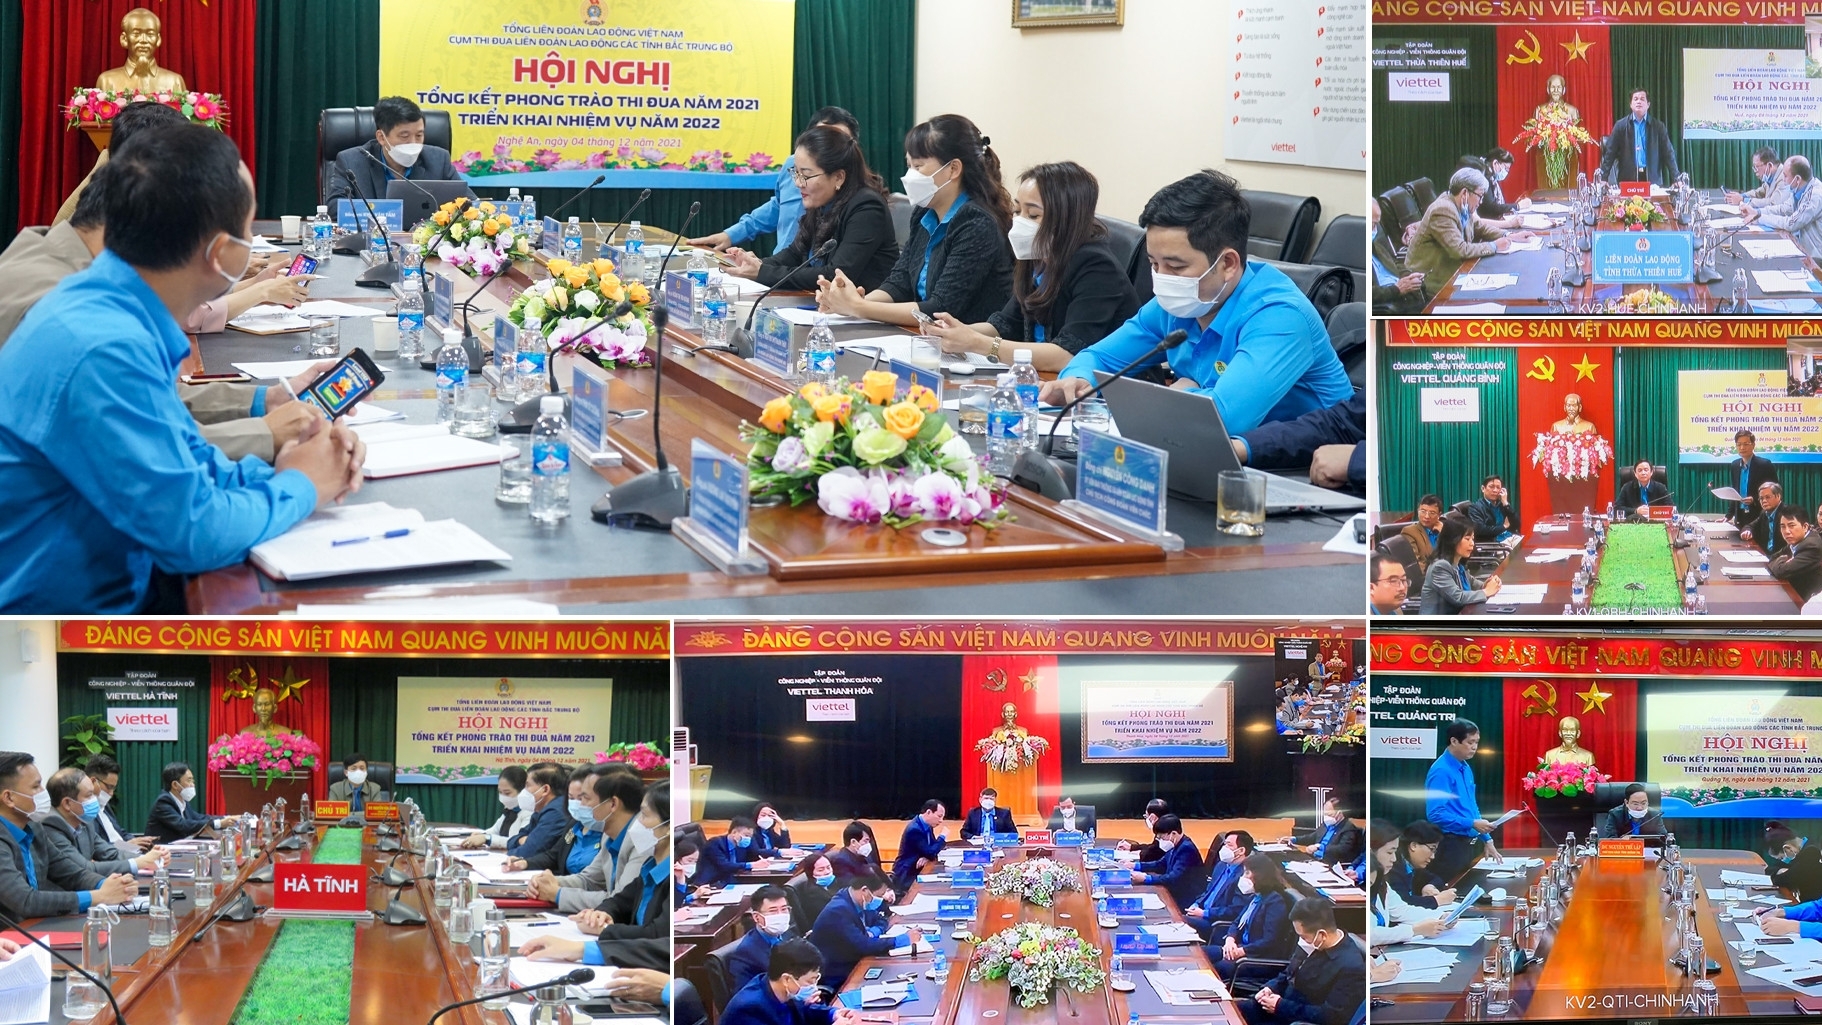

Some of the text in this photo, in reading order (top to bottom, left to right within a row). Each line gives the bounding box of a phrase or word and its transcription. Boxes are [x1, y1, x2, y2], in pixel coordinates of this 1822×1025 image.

[1602, 1, 1796, 16] NAM QUANG VINH
[503, 21, 531, 34] TỔNG
[533, 24, 554, 34] LIÊN
[556, 24, 585, 35] ĐOÀN
[608, 27, 636, 37] ĐỘNG
[638, 27, 659, 38] VIỆT
[660, 30, 684, 38] NAM
[449, 36, 472, 45] CỤM
[492, 37, 513, 45] ĐUA
[514, 36, 536, 45] LIÊN
[538, 37, 567, 46] ĐOÀN
[590, 38, 618, 48] ĐỘNG
[620, 39, 638, 48] CÁC
[641, 39, 663, 49] TỈNH
[665, 40, 684, 50] BẮC
[720, 42, 733, 52] BỘ
[1428, 58, 1450, 66] THIÊN
[514, 50, 670, 91] HỘI NGHỊ
[1396, 78, 1442, 88] viettel
[1733, 79, 1810, 92] HỘI NGHỊ
[417, 86, 759, 110] TỔNG KẾT PHONG TRÀO THI ĐUA NĂM 2021
[458, 107, 720, 130] TRIỂN KHAI NHIỆM VỤ NĂM 2022
[498, 136, 682, 148] Nghệ An, ngày 04 tháng 12 năm 2021
[1271, 142, 1296, 152] viettel
[1605, 253, 1680, 264] LIÊN ĐOÀN LAO ĐỘNG
[1644, 266, 1665, 276] THIÊN
[1668, 264, 1682, 276] HUẾ
[1578, 303, 1707, 314] KV2-HUE-CHINHANH
[1467, 320, 1767, 341] CỘNG VIỆT NAM QUANG VINH
[1401, 374, 1440, 383] VIETTEL
[1478, 372, 1500, 383] BÌNH
[1722, 400, 1802, 414] HỘI NGHỊ
[85, 620, 627, 652] ĐẢNG CỘNG SẢN VIỆT NAM QUANG VINH MUÔN
[742, 624, 1211, 651] ĐẢNG CỘNG SẢN VIỆT NAM QUANG VINH
[1410, 640, 1482, 668] CỘNG
[1492, 639, 1536, 665] SẢN
[1545, 642, 1588, 669] VIỆT
[1599, 647, 1650, 666] NAM
[1659, 647, 1742, 667] QUANG
[1750, 650, 1802, 668] VINH
[143, 691, 155, 700] HÀ
[156, 691, 178, 700] TĨNH
[1383, 685, 1421, 694] TẬP ĐOÀN
[812, 702, 849, 711] viettel
[1405, 695, 1466, 706] THÔNG QUÂN ĐỘI
[116, 714, 169, 725] viettel
[1397, 710, 1437, 721] QUẢNG
[458, 712, 548, 732] HỘI NGHỊ
[412, 730, 434, 741] TỔNG
[437, 731, 453, 741] KẾT
[456, 733, 486, 741] PHONG
[489, 731, 511, 741] TRÀO
[531, 734, 548, 742] ĐUA
[551, 732, 571, 742] NĂM
[1380, 736, 1422, 745] viettel
[432, 743, 458, 753] TRIỂN
[484, 744, 513, 754] NHIỆM
[515, 746, 527, 755] VỤ
[529, 745, 550, 754] NĂM
[1703, 733, 1808, 753] HỘI NGHỊ
[1662, 754, 1686, 763] TỔNG
[1689, 754, 1705, 763] KẾT
[1742, 754, 1765, 763] TRÀO
[1684, 763, 1710, 773] TRIỂN
[1737, 765, 1767, 774] NHIỆM
[1769, 766, 1781, 774] VỤ
[1783, 765, 1805, 773] NĂM
[317, 804, 347, 814] CHỦ TRÌ
[284, 874, 359, 893] HÀ TĨNH
[1565, 993, 1719, 1009] KV2-QTI-CHINHANH
